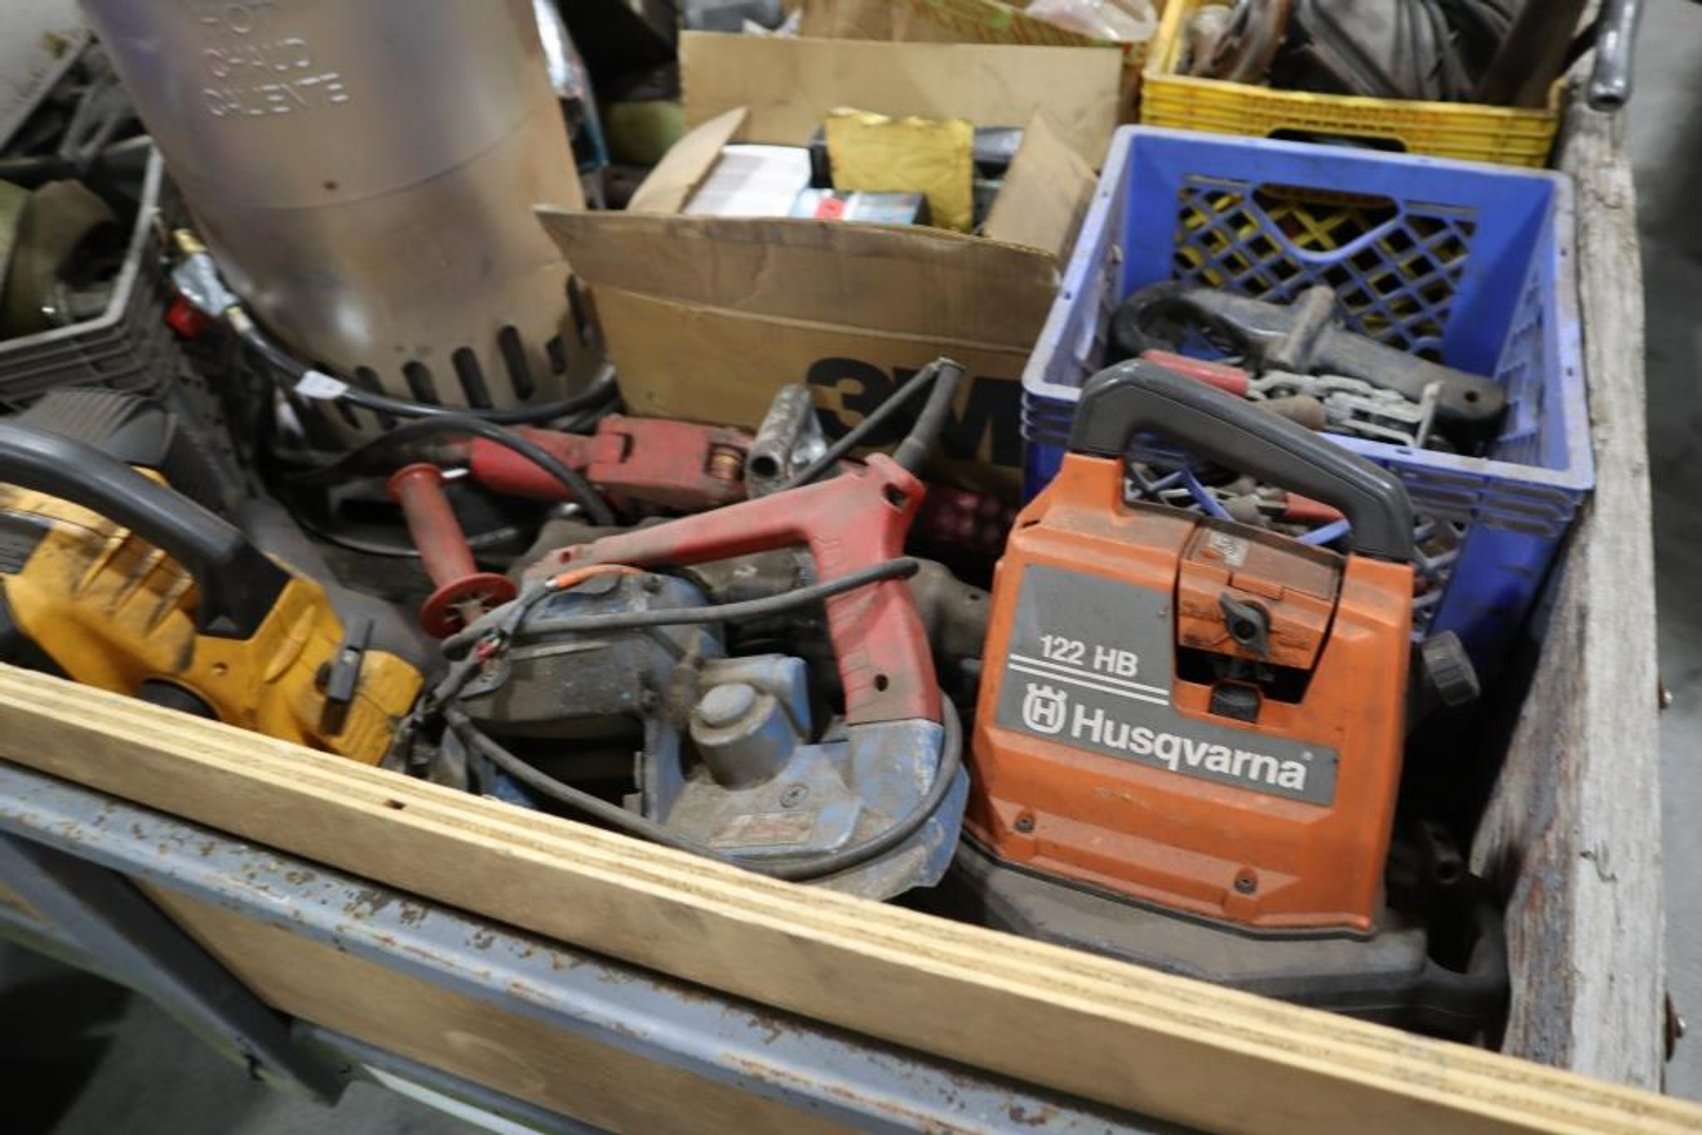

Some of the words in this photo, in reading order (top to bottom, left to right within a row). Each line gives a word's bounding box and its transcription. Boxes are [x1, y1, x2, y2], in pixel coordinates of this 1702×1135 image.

[806, 357, 1023, 467] 3M
[1040, 634, 1084, 665] 122
[1094, 646, 1138, 677] HB
[1071, 704, 1307, 791] Husqvarna
